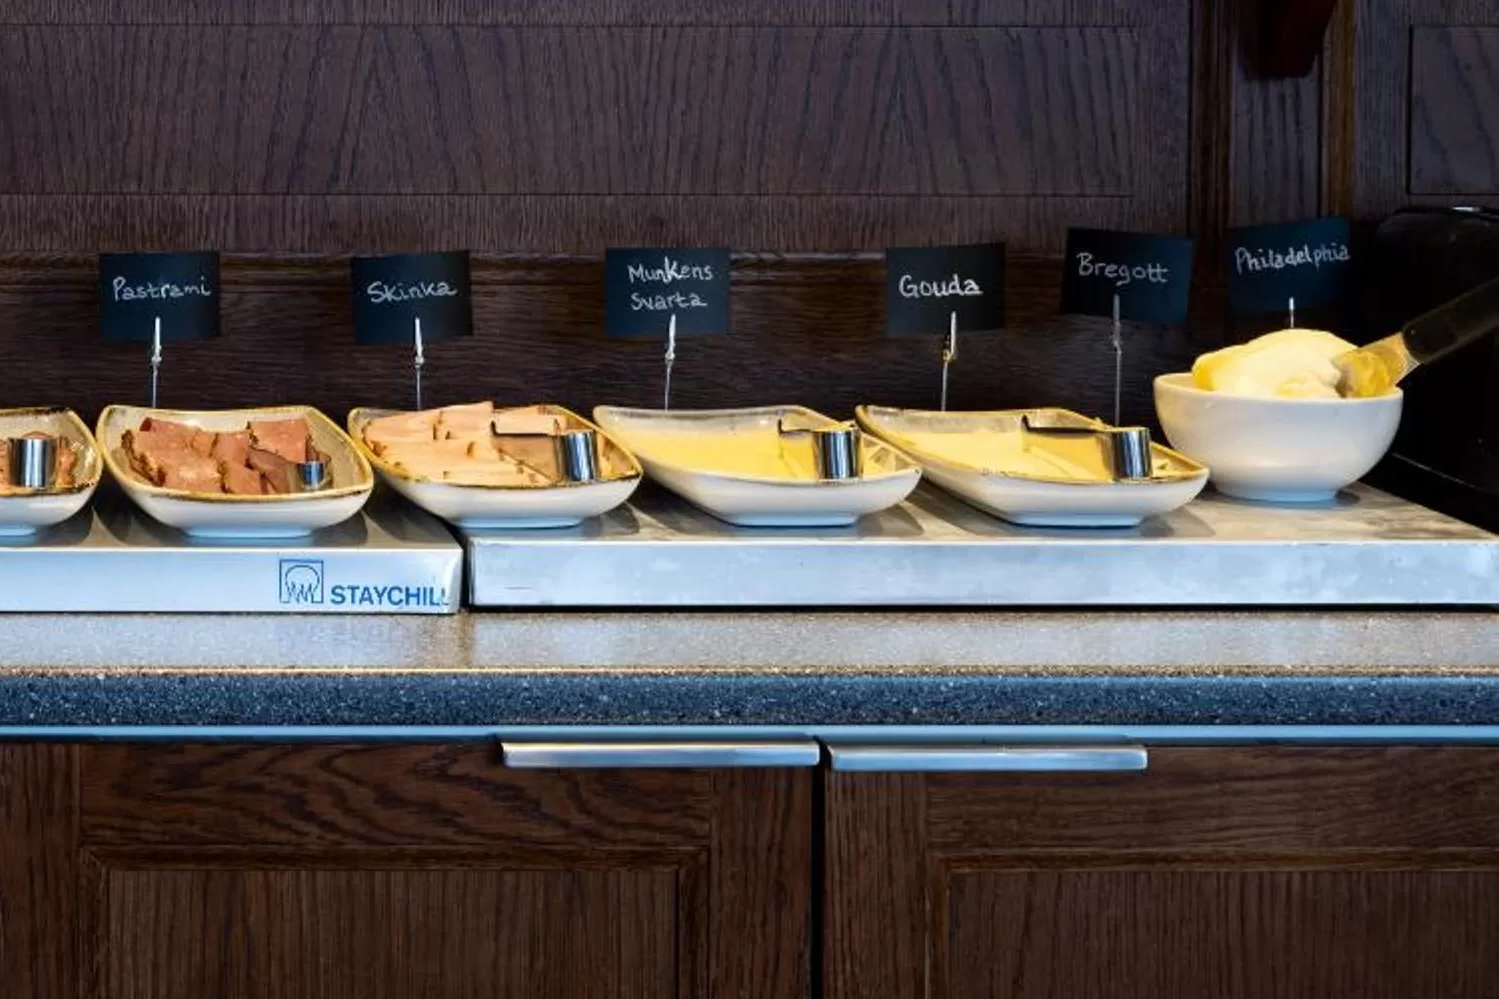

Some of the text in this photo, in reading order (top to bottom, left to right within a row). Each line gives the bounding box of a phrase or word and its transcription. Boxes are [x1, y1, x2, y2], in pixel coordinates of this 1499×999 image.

[626, 255, 715, 285] Munkens
[1076, 251, 1170, 288] Bregott
[1234, 242, 1350, 277] Philadelphia
[112, 275, 213, 303] Pastrami
[366, 279, 459, 303] Skinka
[899, 272, 985, 299] Gouda
